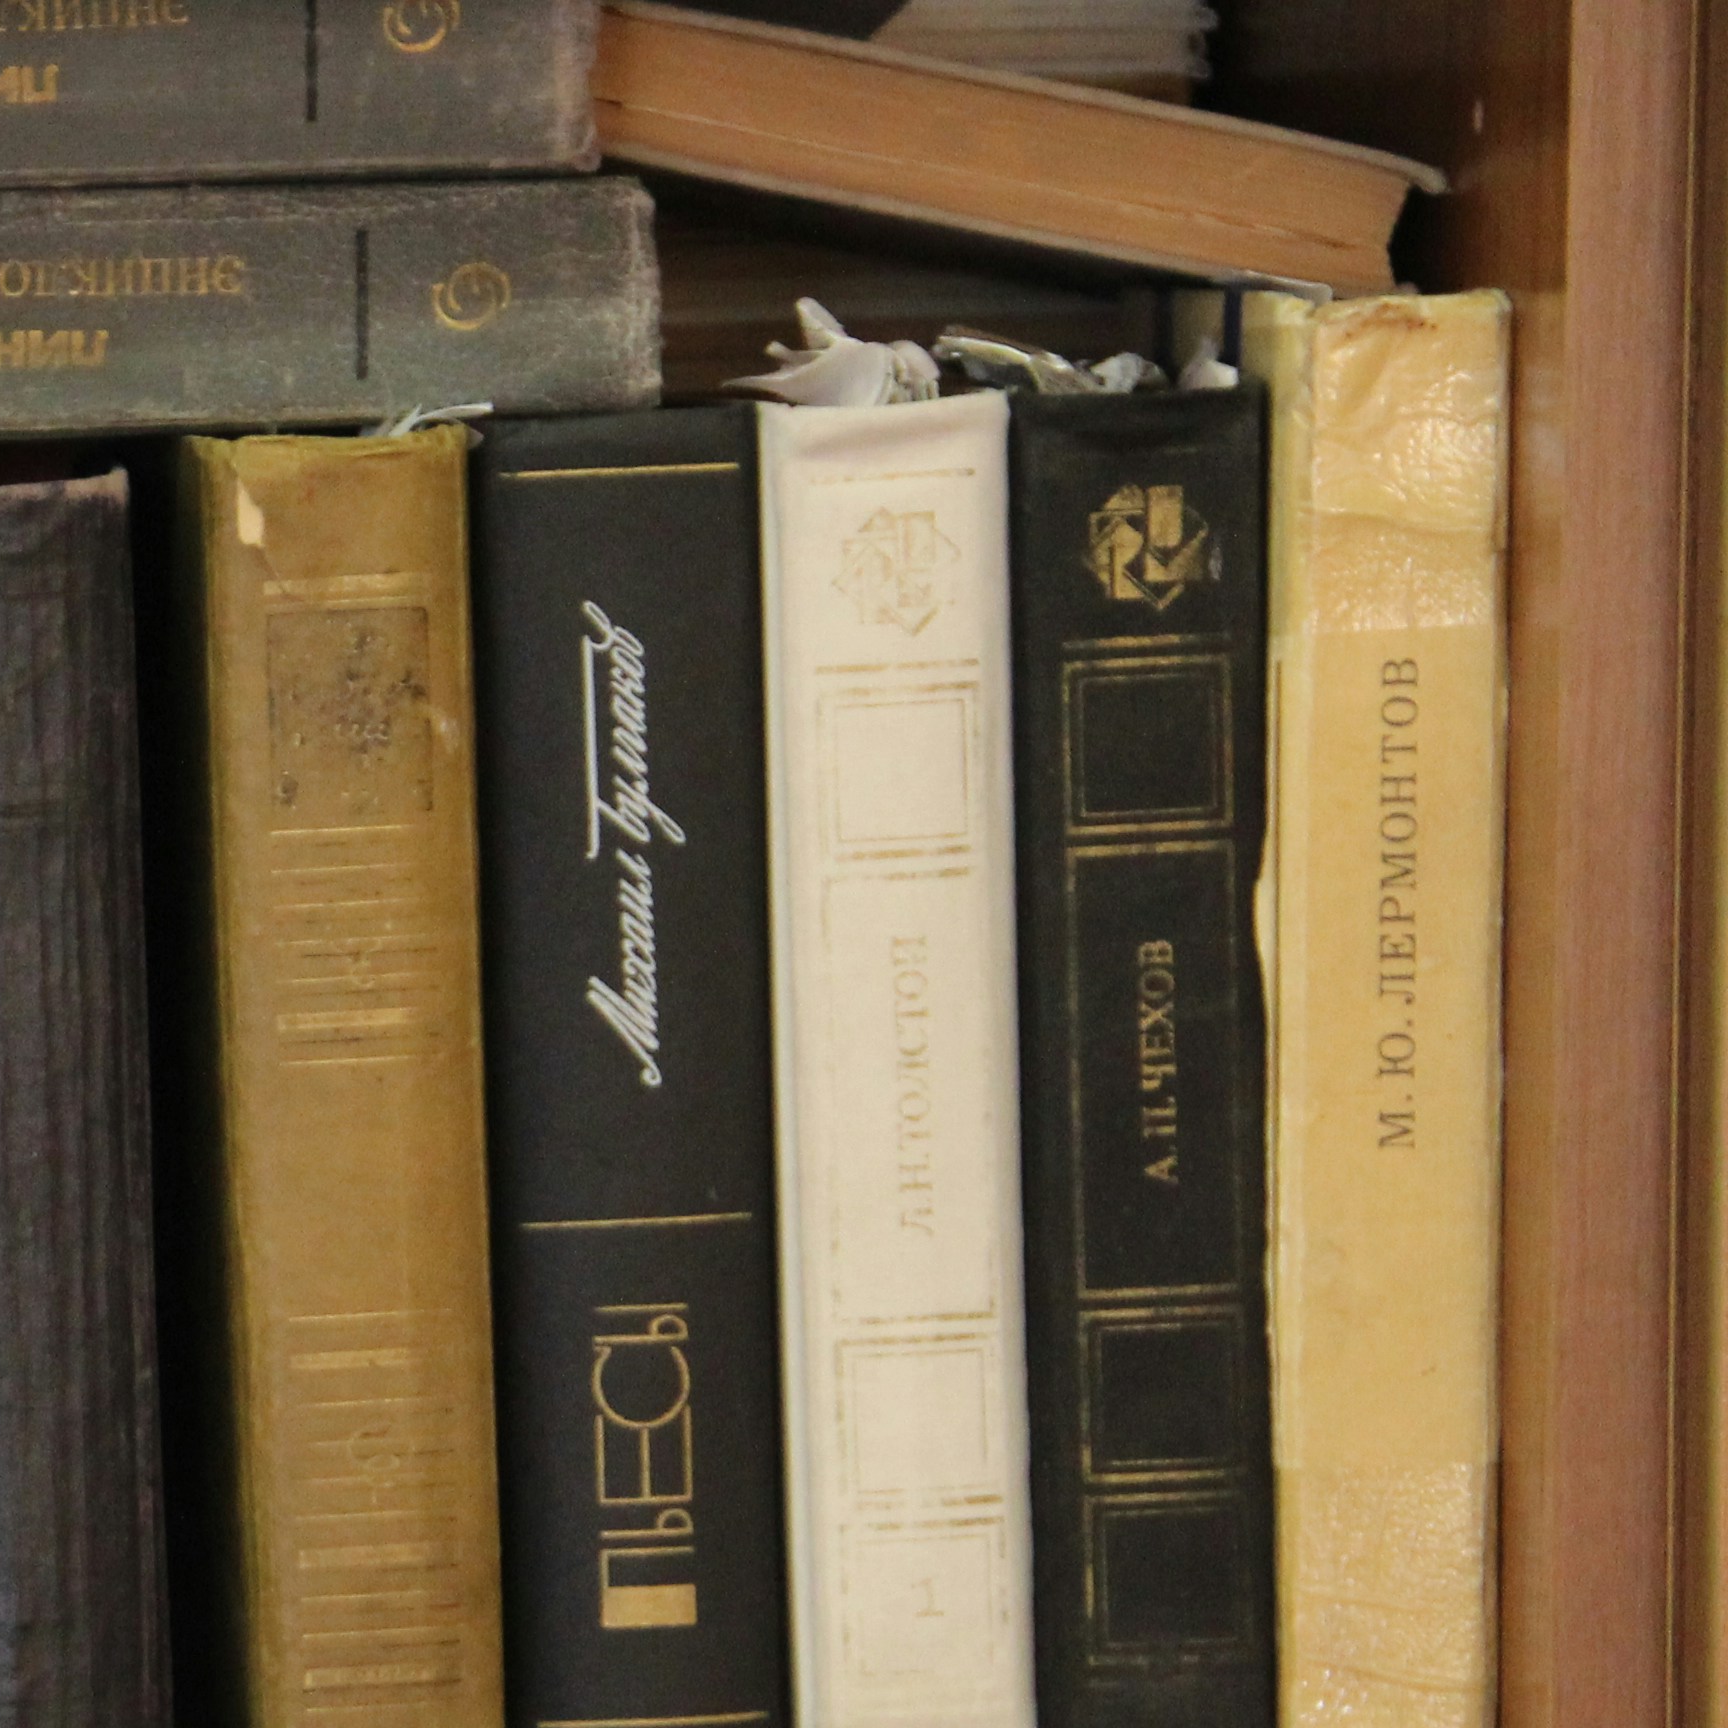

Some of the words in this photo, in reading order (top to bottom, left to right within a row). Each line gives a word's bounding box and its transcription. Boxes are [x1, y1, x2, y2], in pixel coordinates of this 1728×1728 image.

[581, 599, 687, 860] Булгаков
[1377, 656, 1420, 1006] ЛЕРМОНТОВ
[585, 849, 663, 1087] Михаил
[1376, 1020, 1417, 1077] Ю.
[1379, 1094, 1417, 1151] М.
[590, 1301, 698, 1630] ПЬЕСЫ
